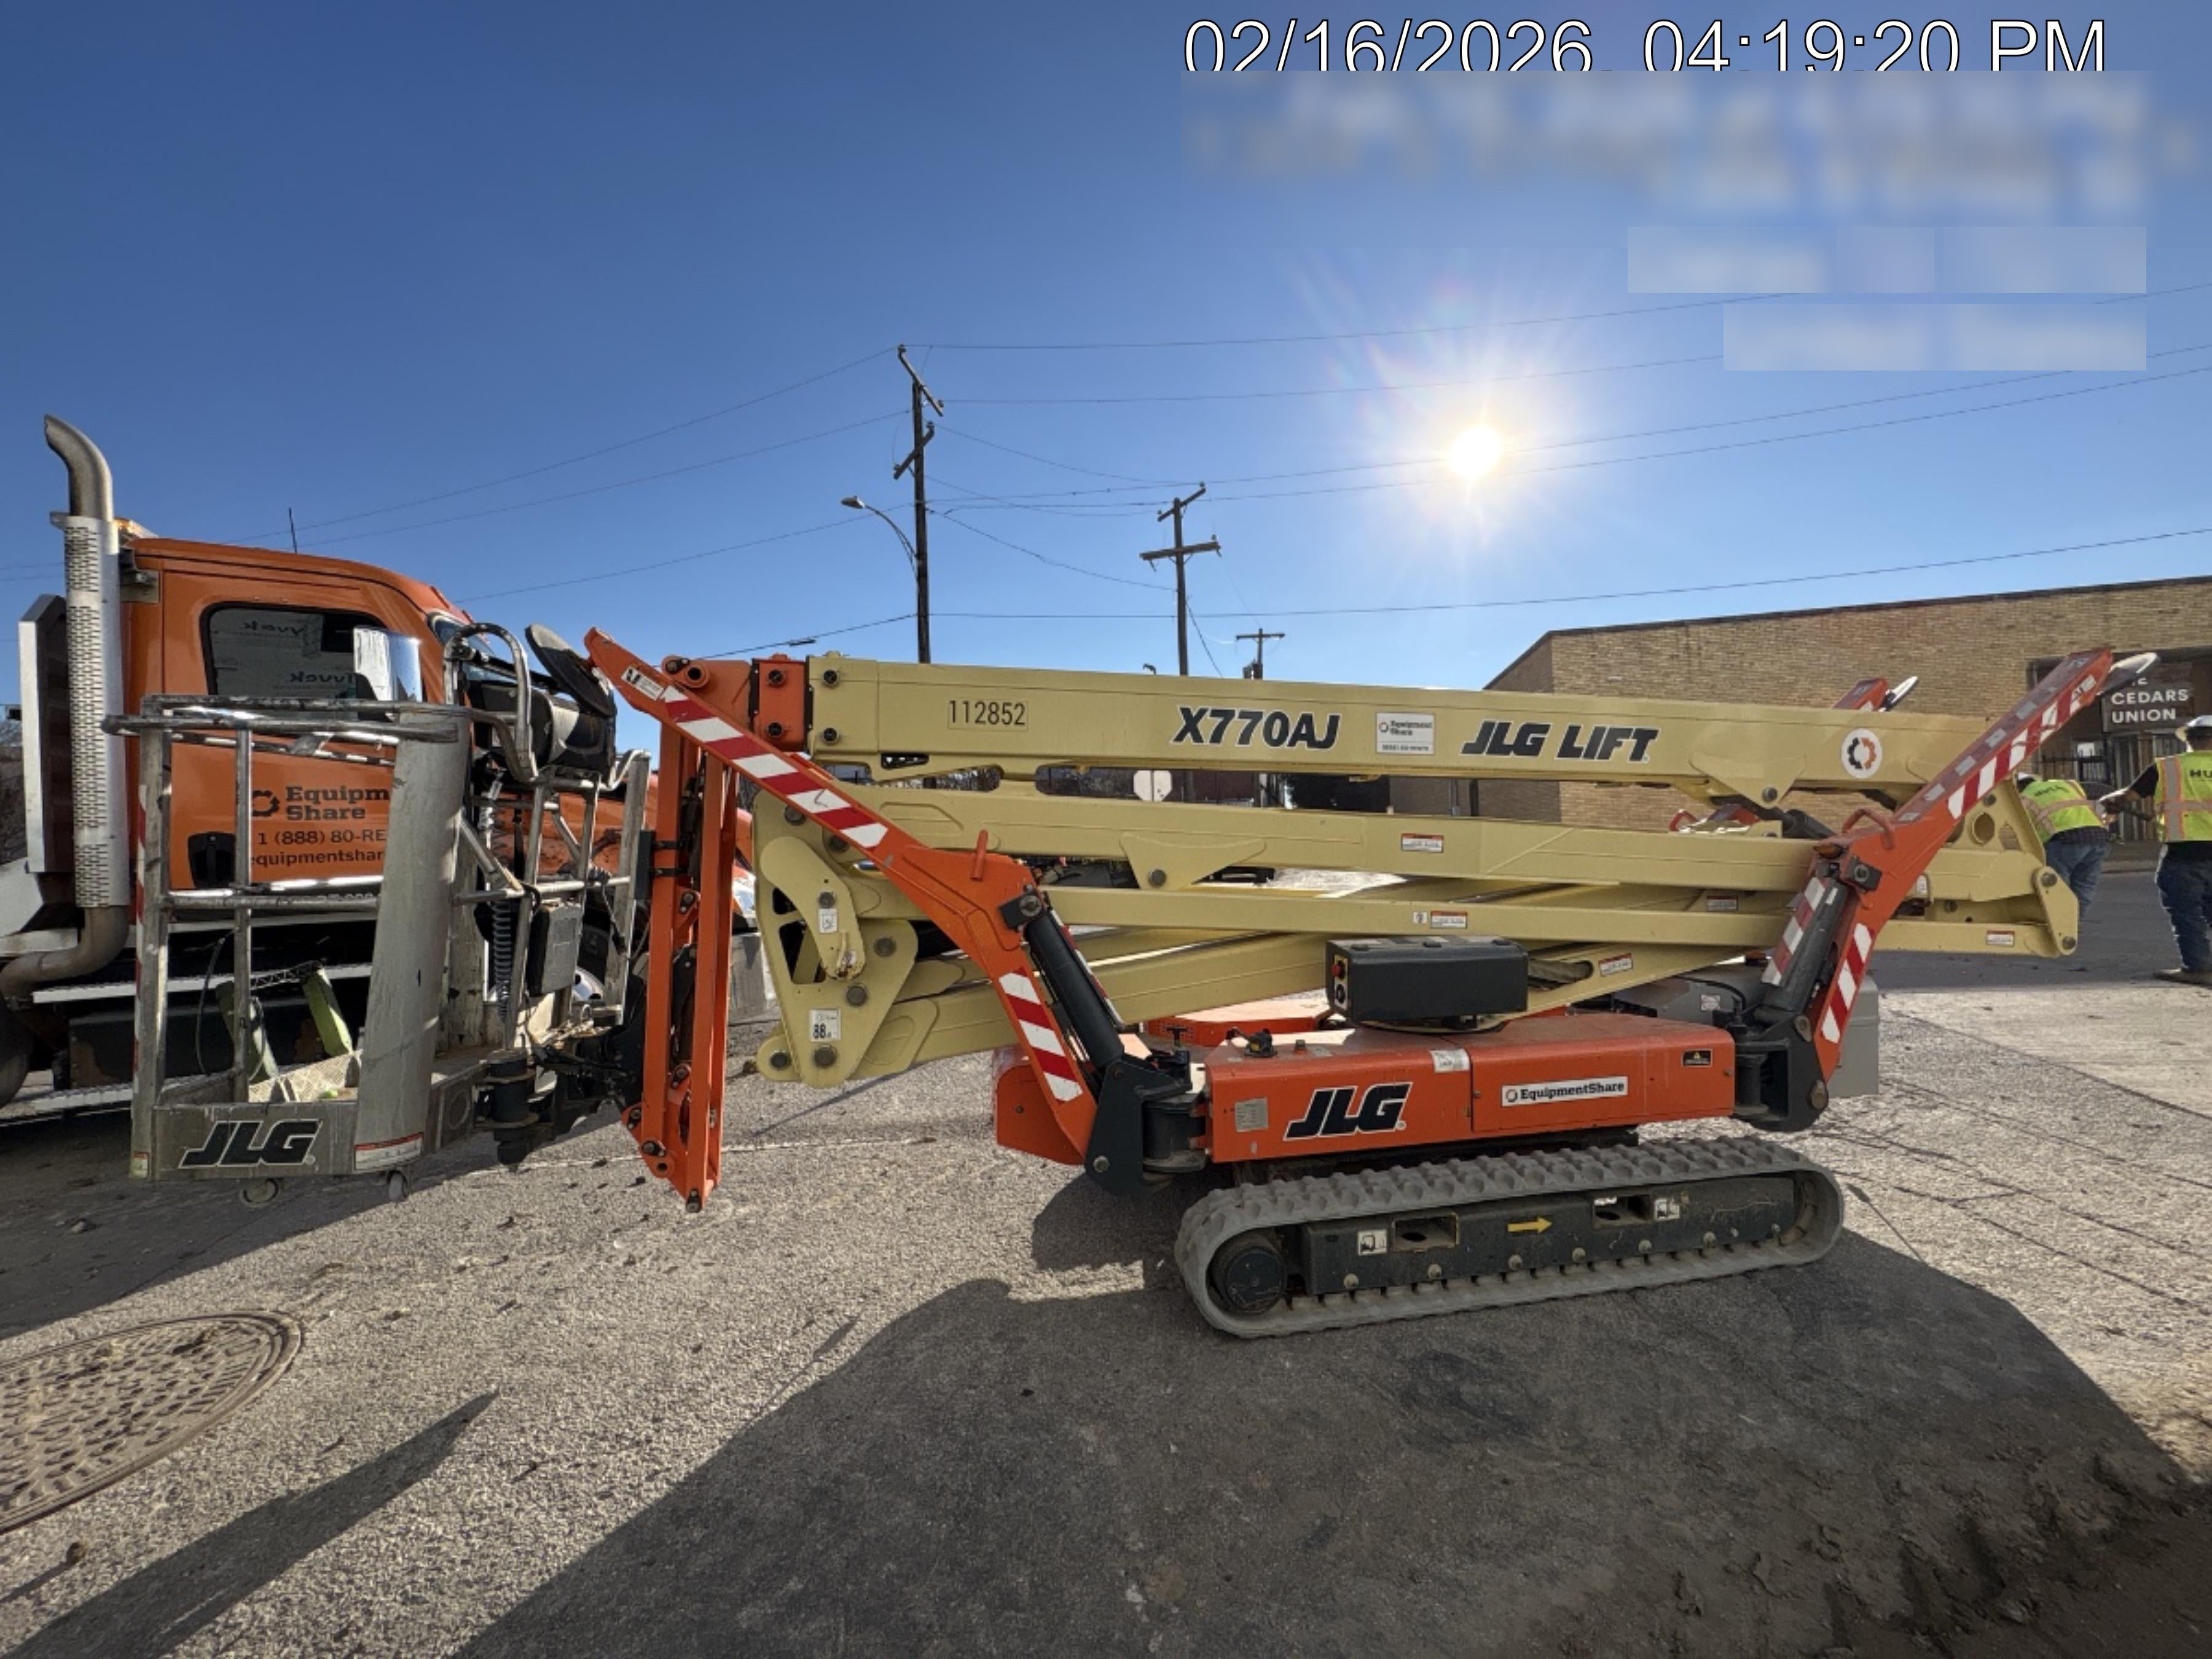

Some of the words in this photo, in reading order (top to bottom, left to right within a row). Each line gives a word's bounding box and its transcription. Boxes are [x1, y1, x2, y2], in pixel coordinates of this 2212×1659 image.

[2111, 688, 2189, 705] CEDARS
[948, 700, 1026, 727] 112852
[2112, 708, 2176, 724] UNION
[1172, 706, 1341, 748] X770AJ
[1461, 720, 1551, 757] JLG
[1556, 725, 1661, 763] LIFT
[286, 805, 366, 821] Share
[257, 833, 267, 845] 1
[275, 831, 325, 845] (888)
[1520, 1081, 1625, 1102] EquipmentShare
[1284, 1083, 1413, 1140] JLG
[179, 1120, 320, 1169] JLG
